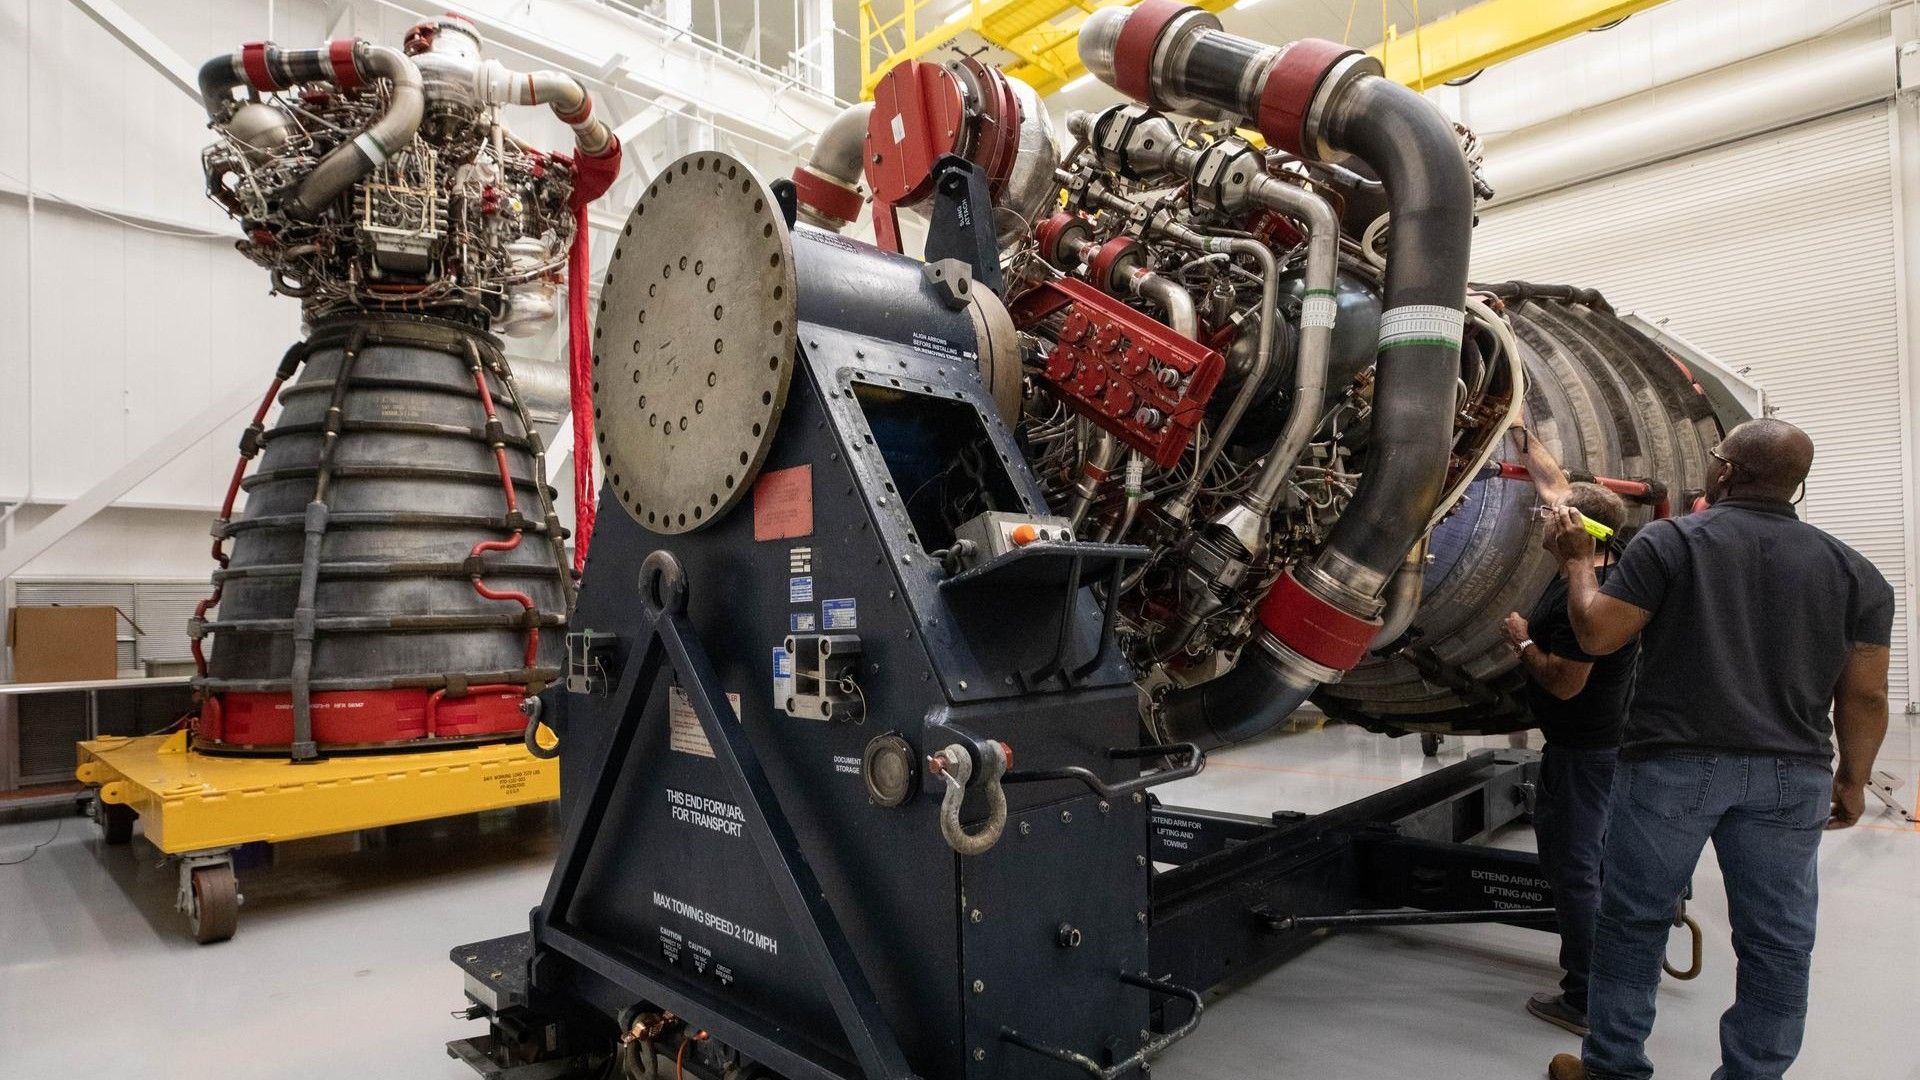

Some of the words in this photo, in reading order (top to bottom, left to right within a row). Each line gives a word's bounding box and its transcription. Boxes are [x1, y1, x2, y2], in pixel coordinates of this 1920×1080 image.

[937, 37, 957, 50] EAST
[957, 205, 965, 227] SLING
[962, 199, 971, 225] ATTACH
[912, 332, 927, 340] ALIGN
[927, 335, 947, 345] ARROWS
[912, 339, 932, 349] BEFORE
[932, 343, 957, 355] INSTALLING
[921, 347, 946, 359] REMOVING
[945, 354, 962, 362] ENGINE
[833, 755, 861, 765] DOCUMENT
[836, 765, 860, 774] STORAGE
[666, 788, 684, 806] THIS
[684, 793, 703, 810] END
[672, 805, 690, 823] FOR
[690, 810, 742, 838] TRANSPORT
[1173, 819, 1188, 828] ARM
[1188, 821, 1202, 830] FOR
[1156, 827, 1180, 837] LIFTING
[1180, 831, 1194, 840] AND
[1163, 838, 1188, 849] TOWING
[1471, 870, 1510, 882] EXTEND
[1510, 875, 1533, 887] ARM
[1534, 879, 1551, 889] FO
[1484, 885, 1520, 898] LIFTING
[1520, 892, 1543, 902] AND
[653, 891, 671, 910] MAX
[671, 898, 704, 923] TOWING
[704, 912, 734, 935] SPEED
[734, 924, 741, 939] 2
[742, 927, 755, 945] 1/2
[755, 932, 778, 955] MPH
[660, 926, 682, 942] CAUTION
[660, 935, 677, 947] CONNECT
[663, 943, 678, 954] FACILITY
[687, 940, 712, 957] CAUTION
[715, 968, 734, 983] BREAKER
